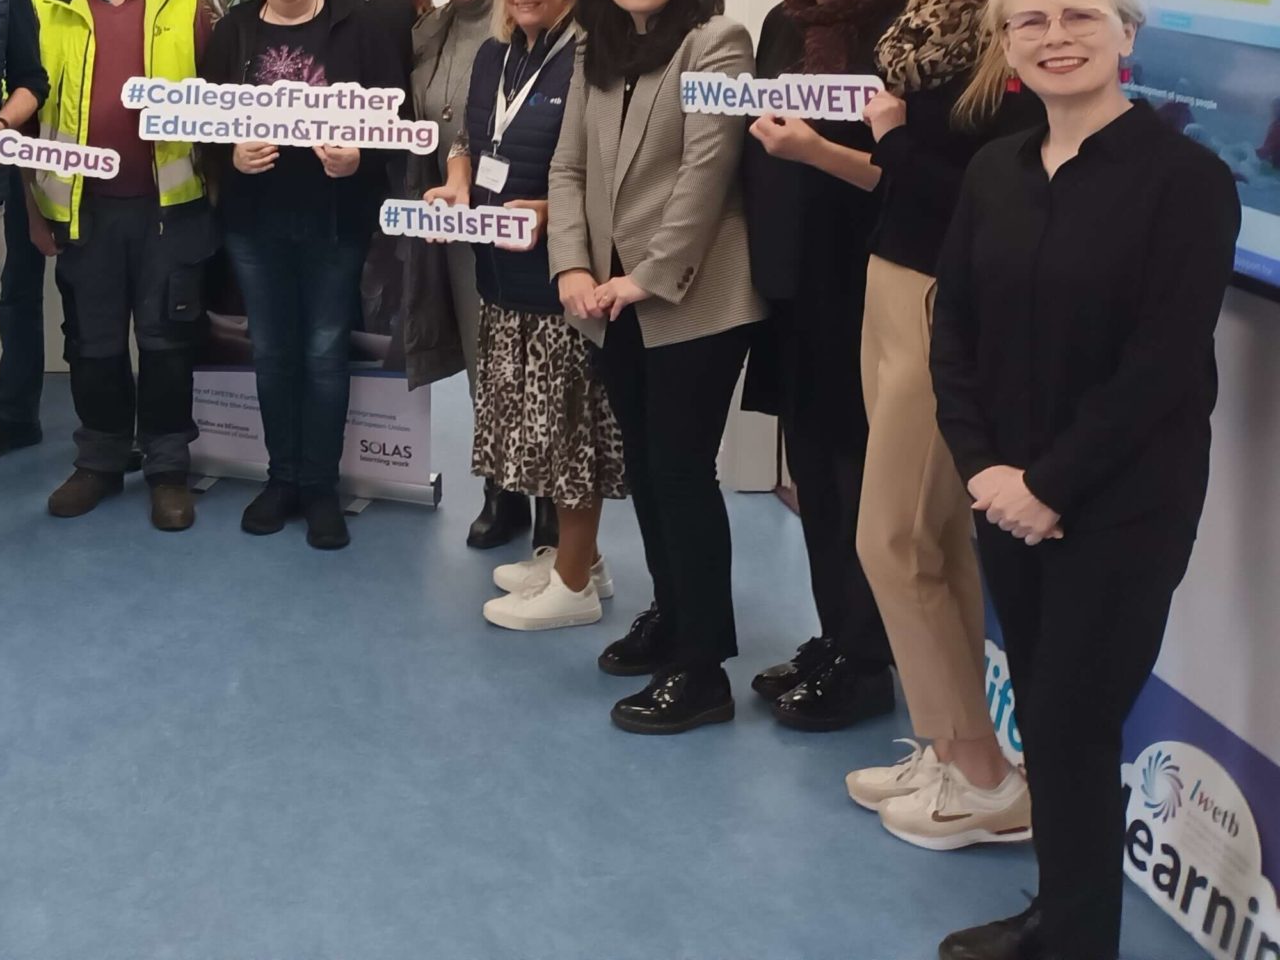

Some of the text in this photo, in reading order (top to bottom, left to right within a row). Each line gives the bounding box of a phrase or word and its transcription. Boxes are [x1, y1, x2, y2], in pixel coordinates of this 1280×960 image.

[128, 83, 399, 111] #CollegeofFurther
[145, 114, 434, 148] Education&Training
[384, 206, 529, 239] #ThisIsFET
[360, 440, 412, 459] SOLAS
